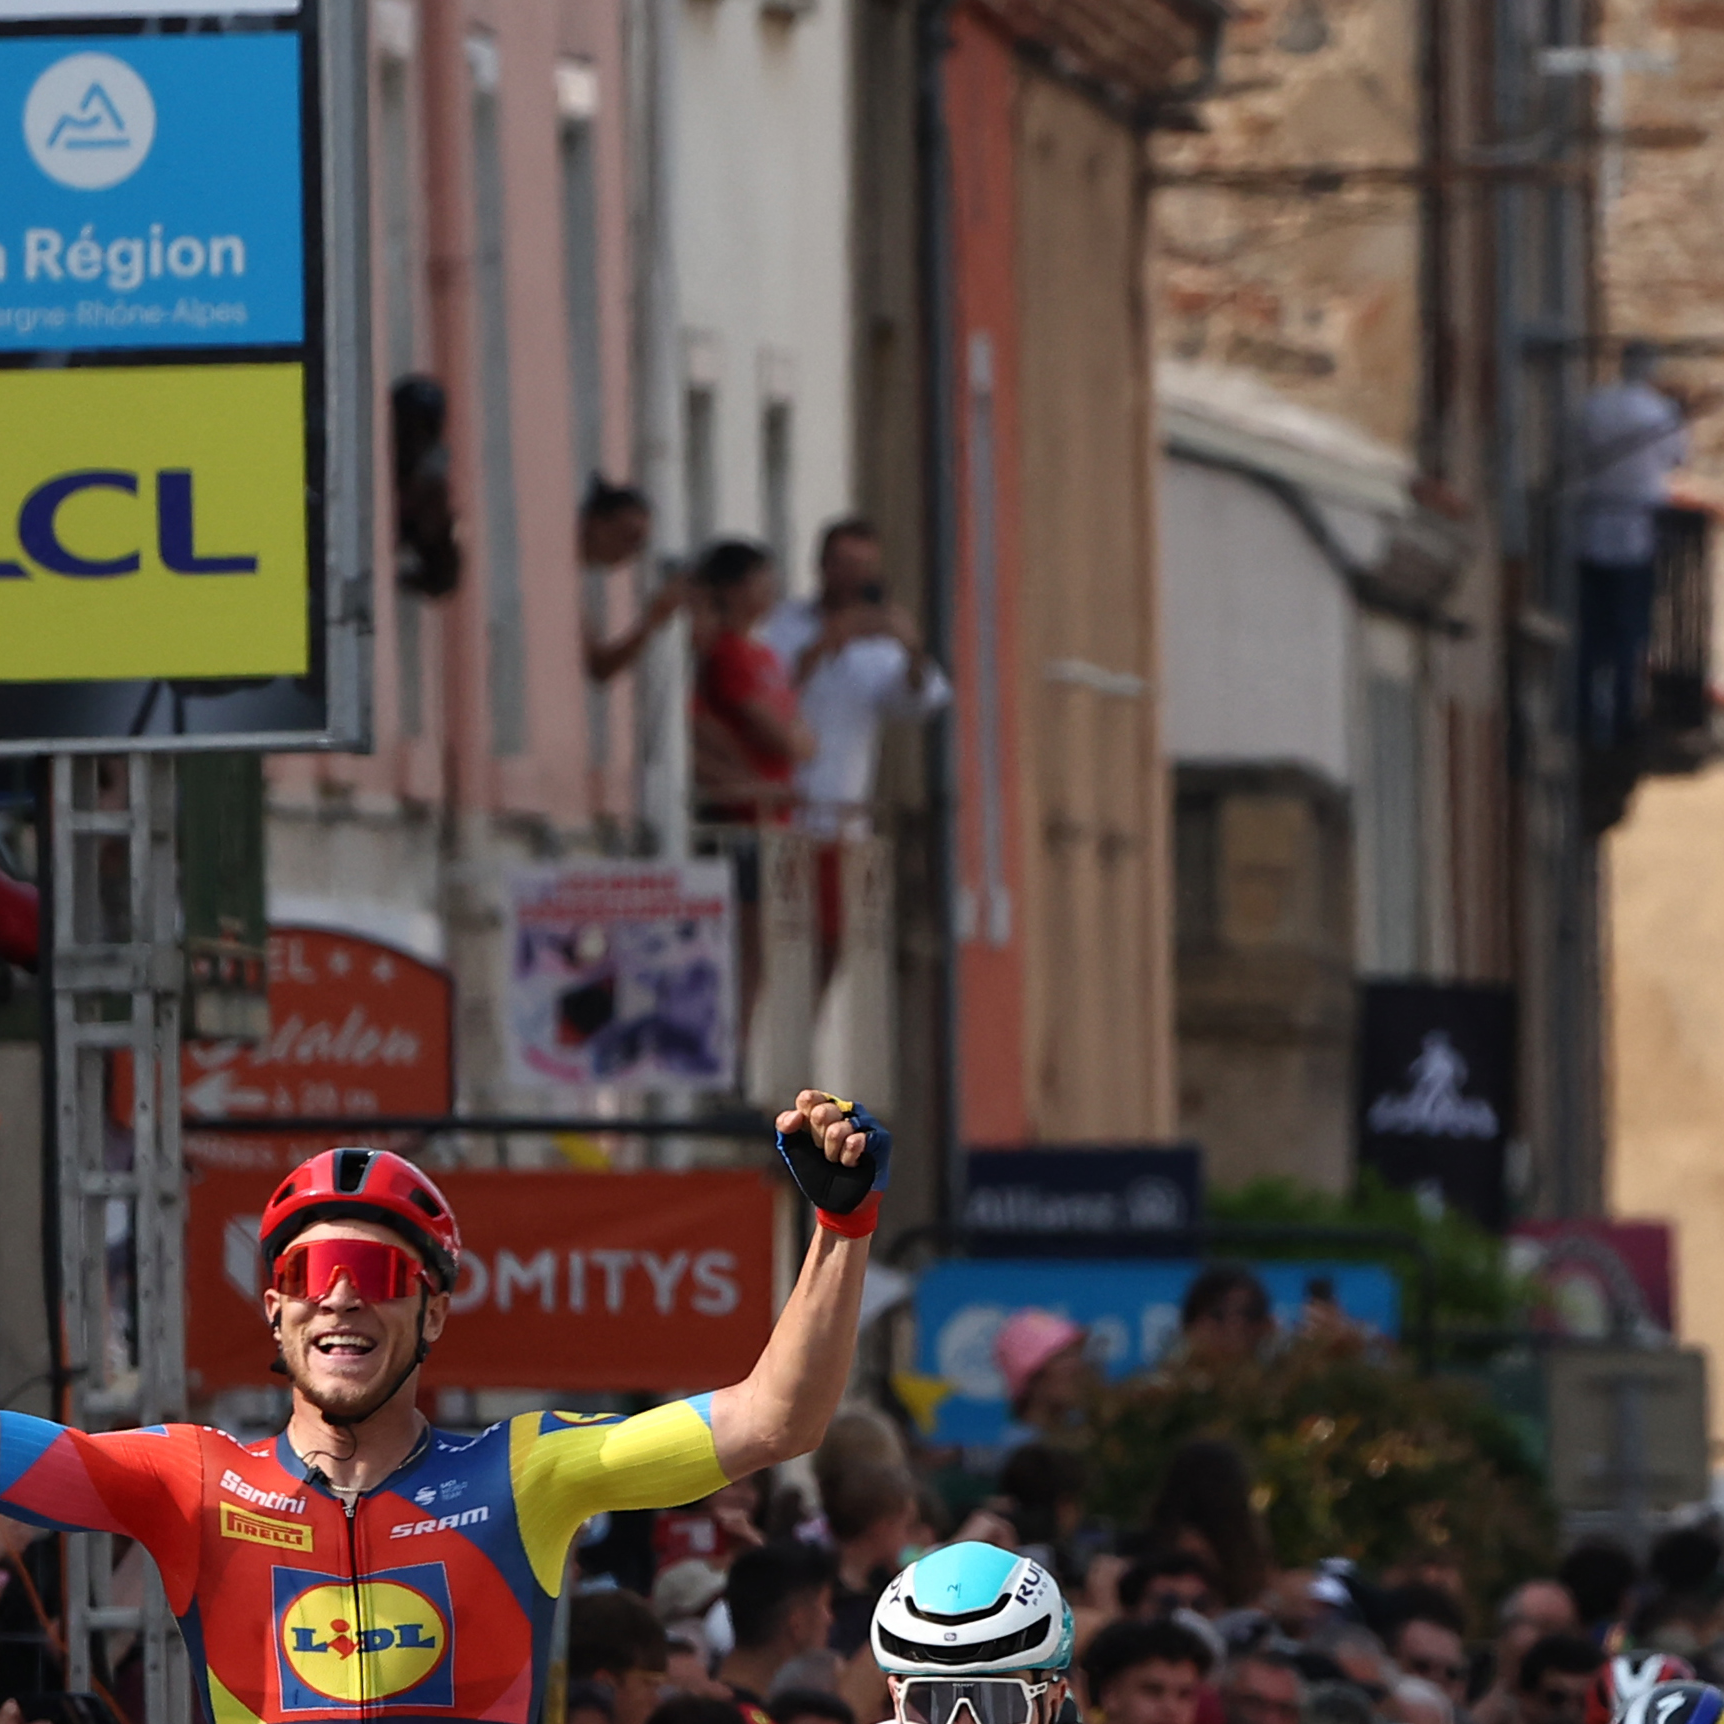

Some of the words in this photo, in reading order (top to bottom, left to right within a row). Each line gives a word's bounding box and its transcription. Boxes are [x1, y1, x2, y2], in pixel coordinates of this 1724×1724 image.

[23, 222, 247, 290] Région
[449, 1250, 741, 1319] OMITYS
[219, 1468, 307, 1515] Santini
[227, 1504, 305, 1546] PIRELLI
[389, 1505, 490, 1540] SRAM
